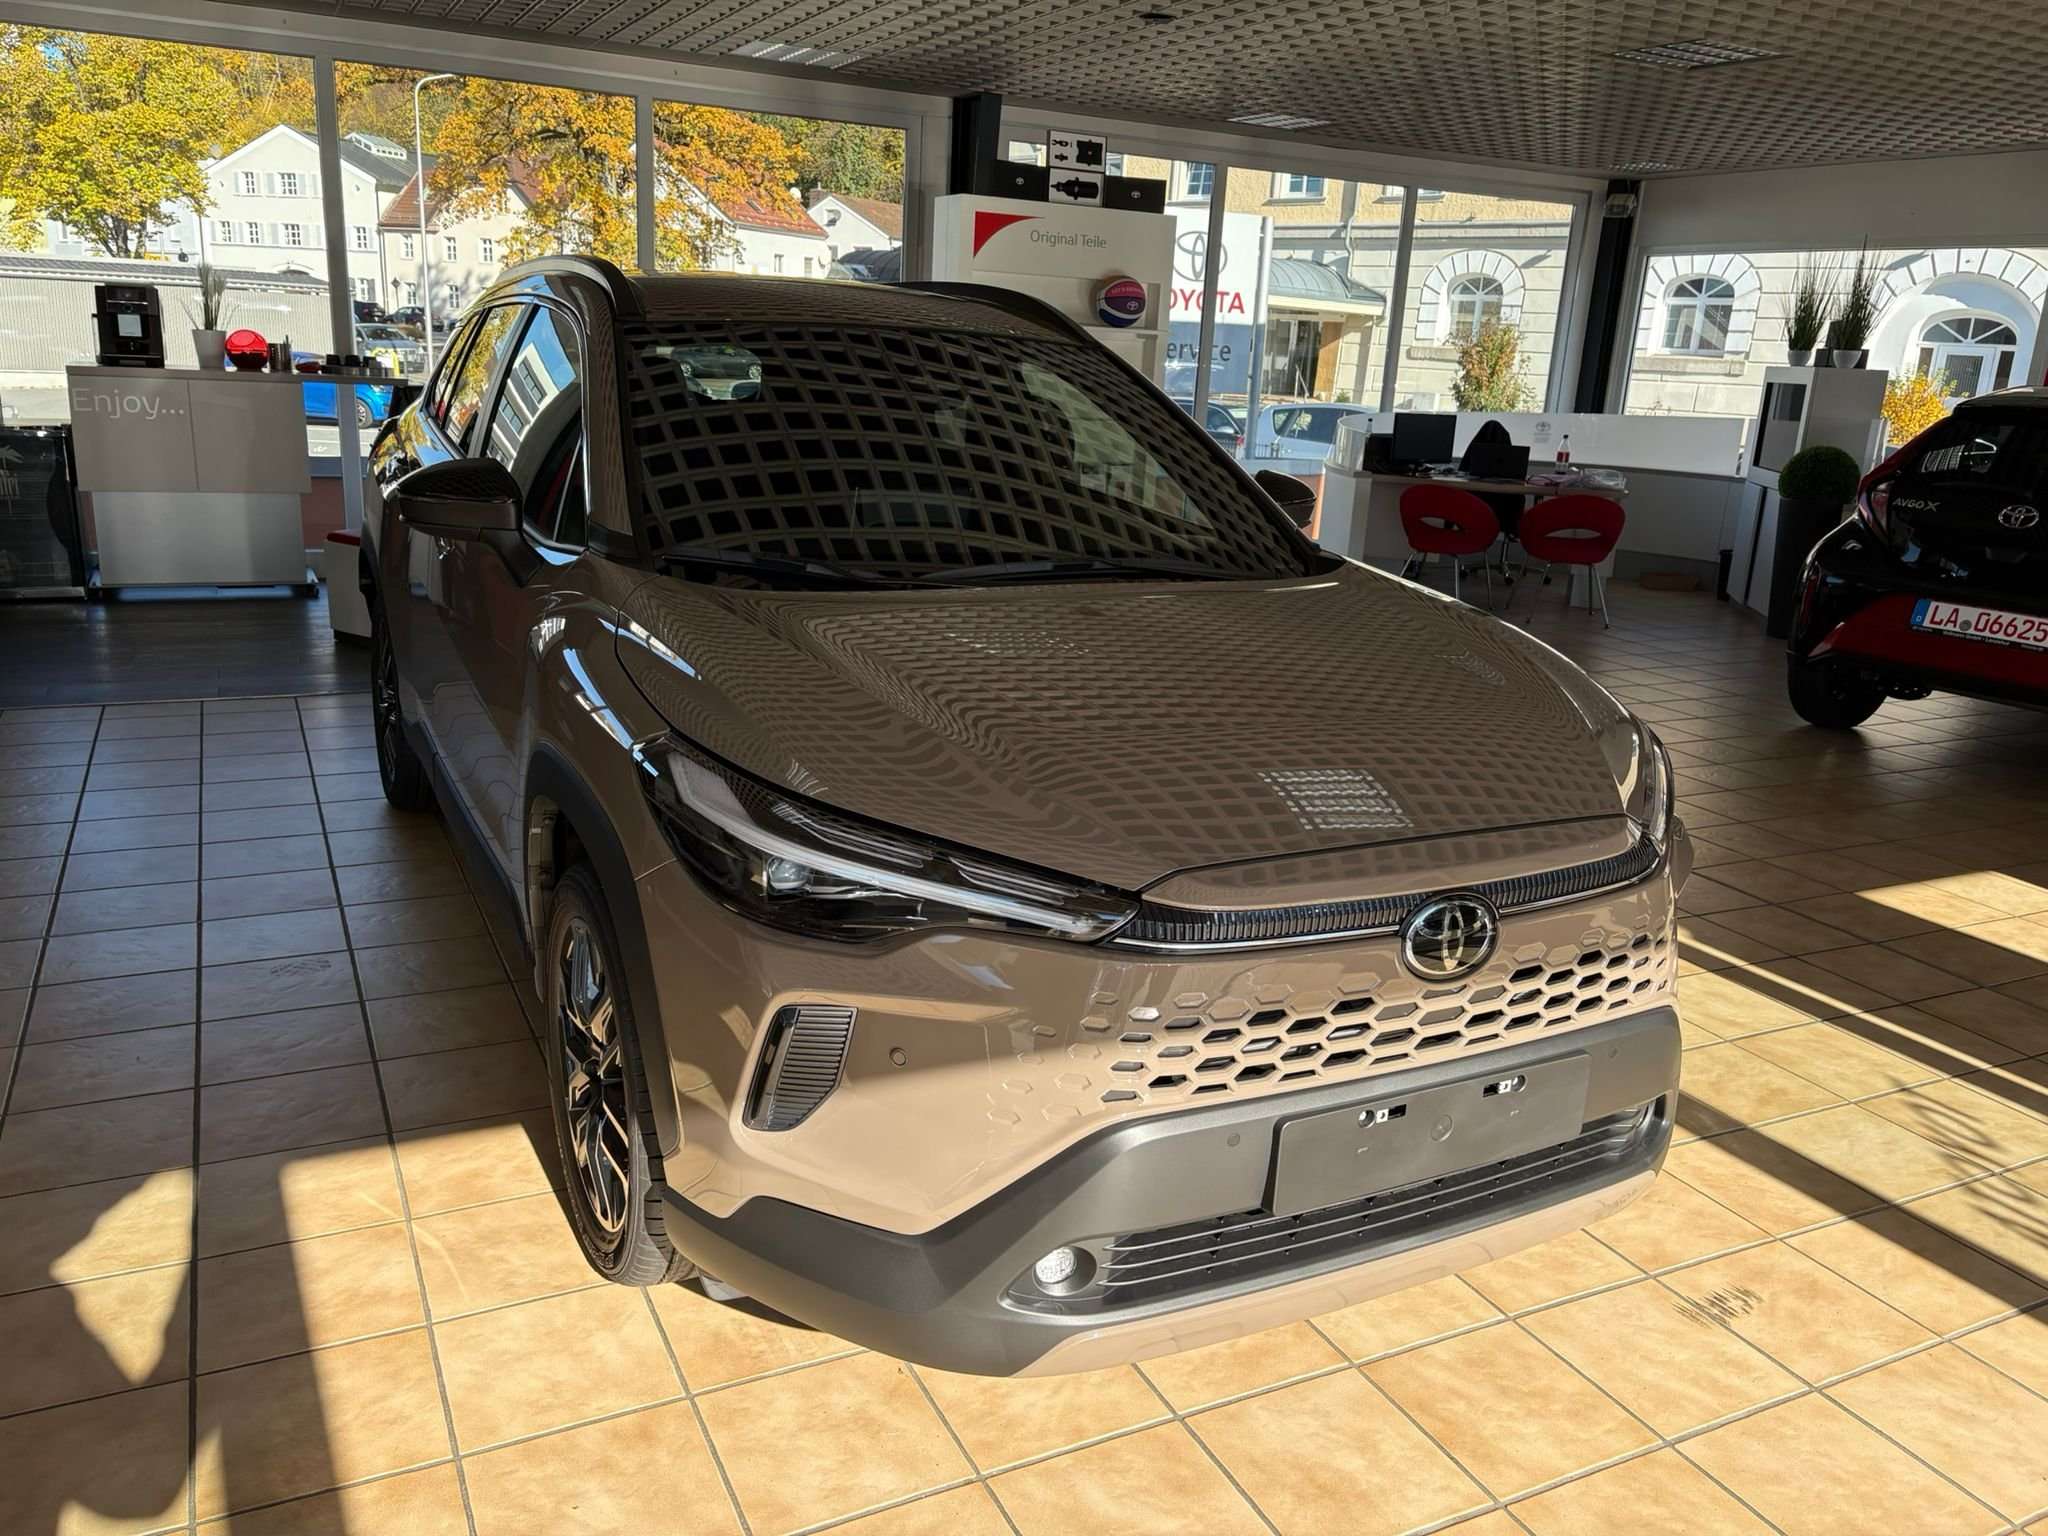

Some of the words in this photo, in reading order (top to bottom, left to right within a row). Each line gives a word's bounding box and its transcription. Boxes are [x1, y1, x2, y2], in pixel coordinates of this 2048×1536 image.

[1030, 229, 1078, 248] Original
[1080, 233, 1107, 249] Teile
[71, 387, 184, 420] Enjoy...
[1929, 604, 1960, 629] LA
[1973, 611, 2048, 643] 06625
